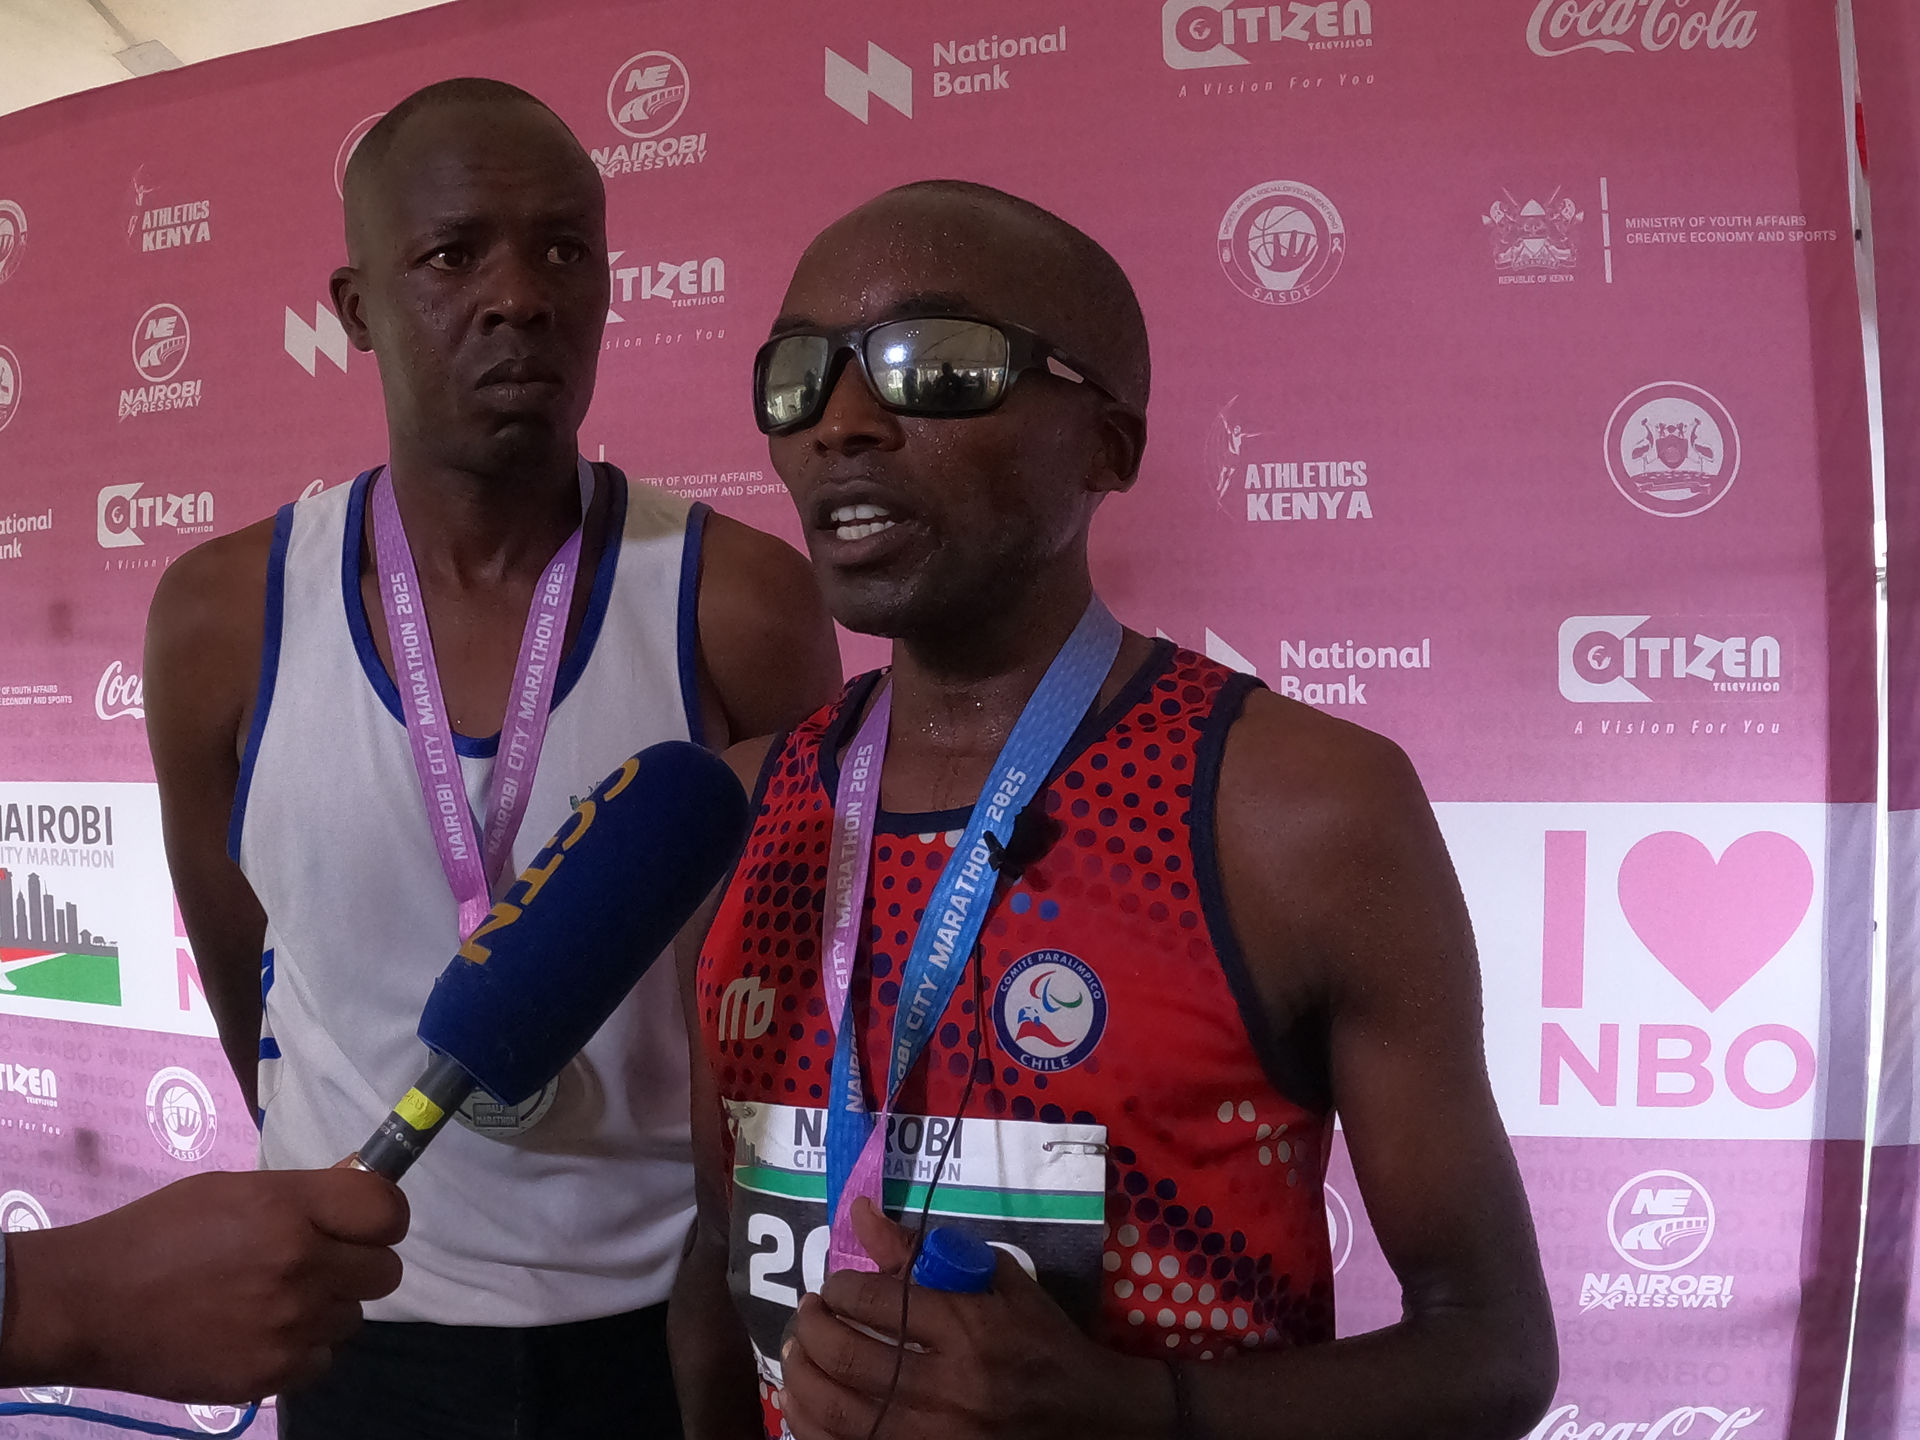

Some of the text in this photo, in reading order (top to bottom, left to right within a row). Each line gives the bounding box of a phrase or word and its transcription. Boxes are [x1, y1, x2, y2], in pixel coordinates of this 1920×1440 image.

[933, 26, 1066, 67] National
[1162, 0, 1372, 70] CITIZEN
[1308, 39, 1373, 51] TELEVISION
[933, 64, 1010, 98] Bank
[1178, 73, 1375, 98] A Vision For You
[590, 133, 708, 165] NAIROBI
[596, 150, 708, 179] XPRESSWAY
[142, 200, 210, 230] ATHLETICS
[1625, 214, 1807, 229] MINISTRY OF YOUTH AFFAIRS
[142, 221, 211, 252] KENYA
[1626, 230, 1837, 244] CREATIVE ECONOMY AND SPORTS
[1252, 285, 1313, 303] SASDF
[605, 328, 726, 351] sion For You
[120, 379, 202, 404] NAIROBI
[118, 395, 202, 423] EXPRESSWAY
[666, 475, 681, 487] OF
[682, 473, 718, 486] YOUTH
[719, 470, 763, 484] AFFAIRS
[1244, 460, 1368, 489] ATHLETICS
[720, 485, 744, 497] AND
[746, 483, 789, 495] SPORTS
[97, 481, 214, 549] CITIZEN
[1247, 490, 1374, 521] KENYA
[0, 508, 52, 535] ational
[1280, 638, 1431, 669] National
[1558, 615, 1781, 702] CITIZEN
[1280, 675, 1368, 705] Bank
[1712, 681, 1781, 692] TELEVISION
[390, 571, 469, 860] NAIROBI CITY MARATHON 2025
[487, 562, 566, 856] NAIROBI CITY MARATHON 2025
[1574, 719, 1781, 734] A Vision For You
[0, 802, 114, 846] AIROBI
[836, 801, 863, 929] MARATHON
[850, 743, 874, 794] 2025
[0, 847, 115, 869] ITY MARATHON
[905, 765, 1028, 1034] CITY MARATHO 2025
[1541, 830, 1587, 1009] I
[1038, 952, 1102, 1000] PARALIMPICO
[1019, 1053, 1071, 1071] CHILE
[1538, 1022, 1816, 1110] NBO
[793, 1108, 963, 1159] NROBI
[792, 1148, 826, 1169] CIT
[1582, 1272, 1735, 1296] NAIROBI
[1579, 1289, 1735, 1315] EXPRESSWAY
